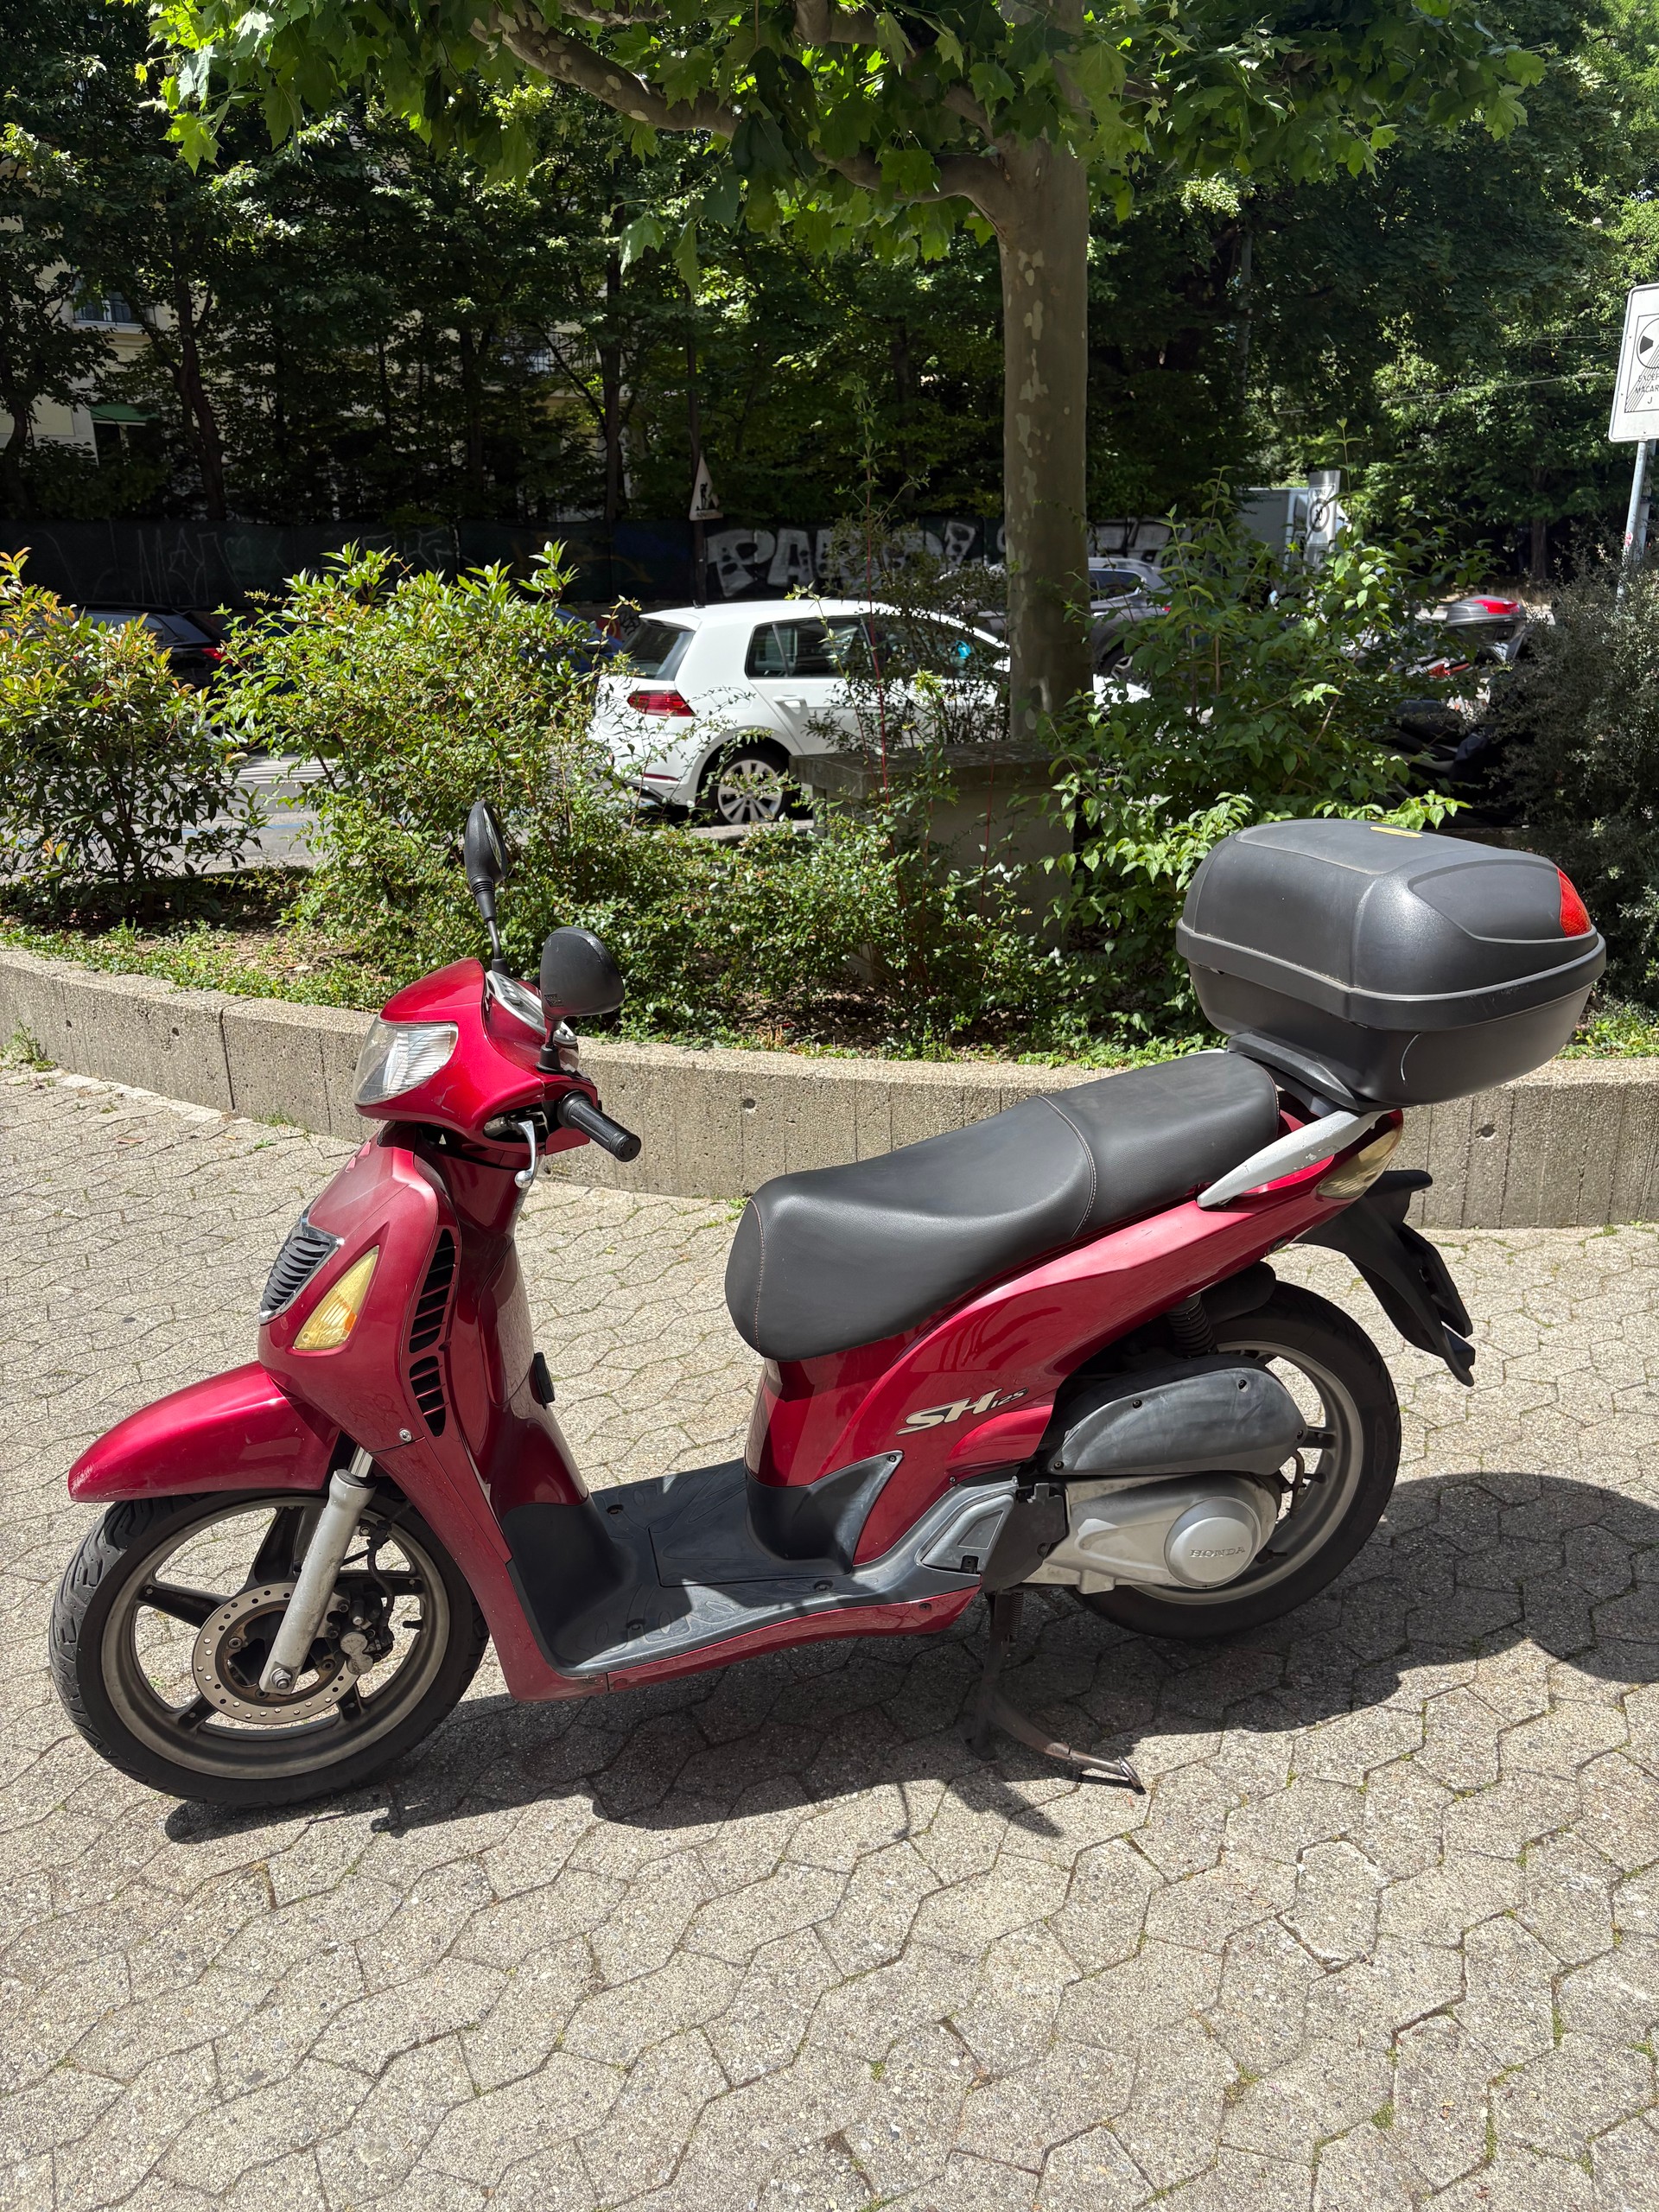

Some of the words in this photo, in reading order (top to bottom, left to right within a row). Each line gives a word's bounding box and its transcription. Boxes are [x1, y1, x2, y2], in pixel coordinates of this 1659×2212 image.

[896, 1388, 1003, 1436] SH
[991, 1388, 1027, 1409] 125
[1189, 1546, 1246, 1558] HONDA
